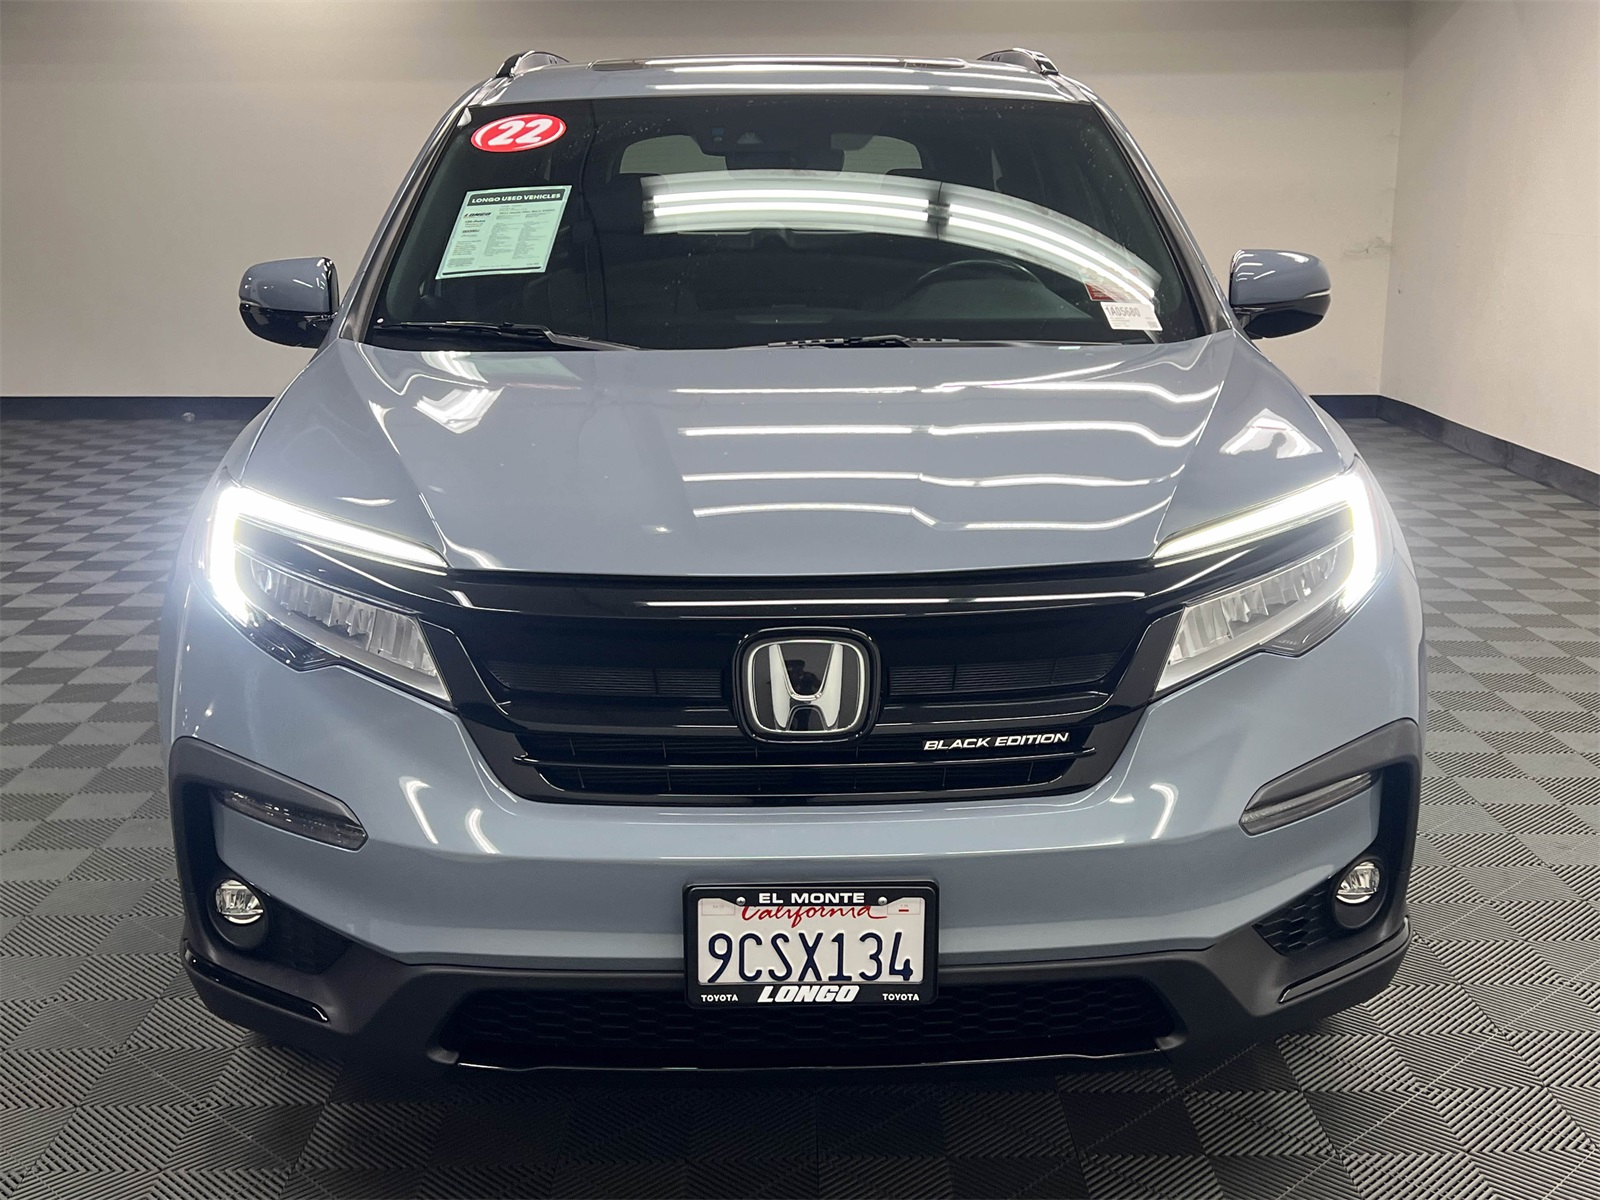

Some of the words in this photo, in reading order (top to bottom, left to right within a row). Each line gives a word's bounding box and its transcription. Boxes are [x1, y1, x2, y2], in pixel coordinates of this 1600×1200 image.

[488, 118, 553, 146] 22
[923, 737, 992, 751] BLACK
[994, 732, 1070, 747] EDITION
[758, 892, 784, 904] EL
[791, 892, 865, 904] MONTE
[741, 905, 888, 929] California
[707, 931, 914, 983] 9CSX134
[701, 993, 739, 1002] TOYOTA
[757, 985, 860, 1003] LONGO
[882, 993, 920, 1002] TOYOTA
